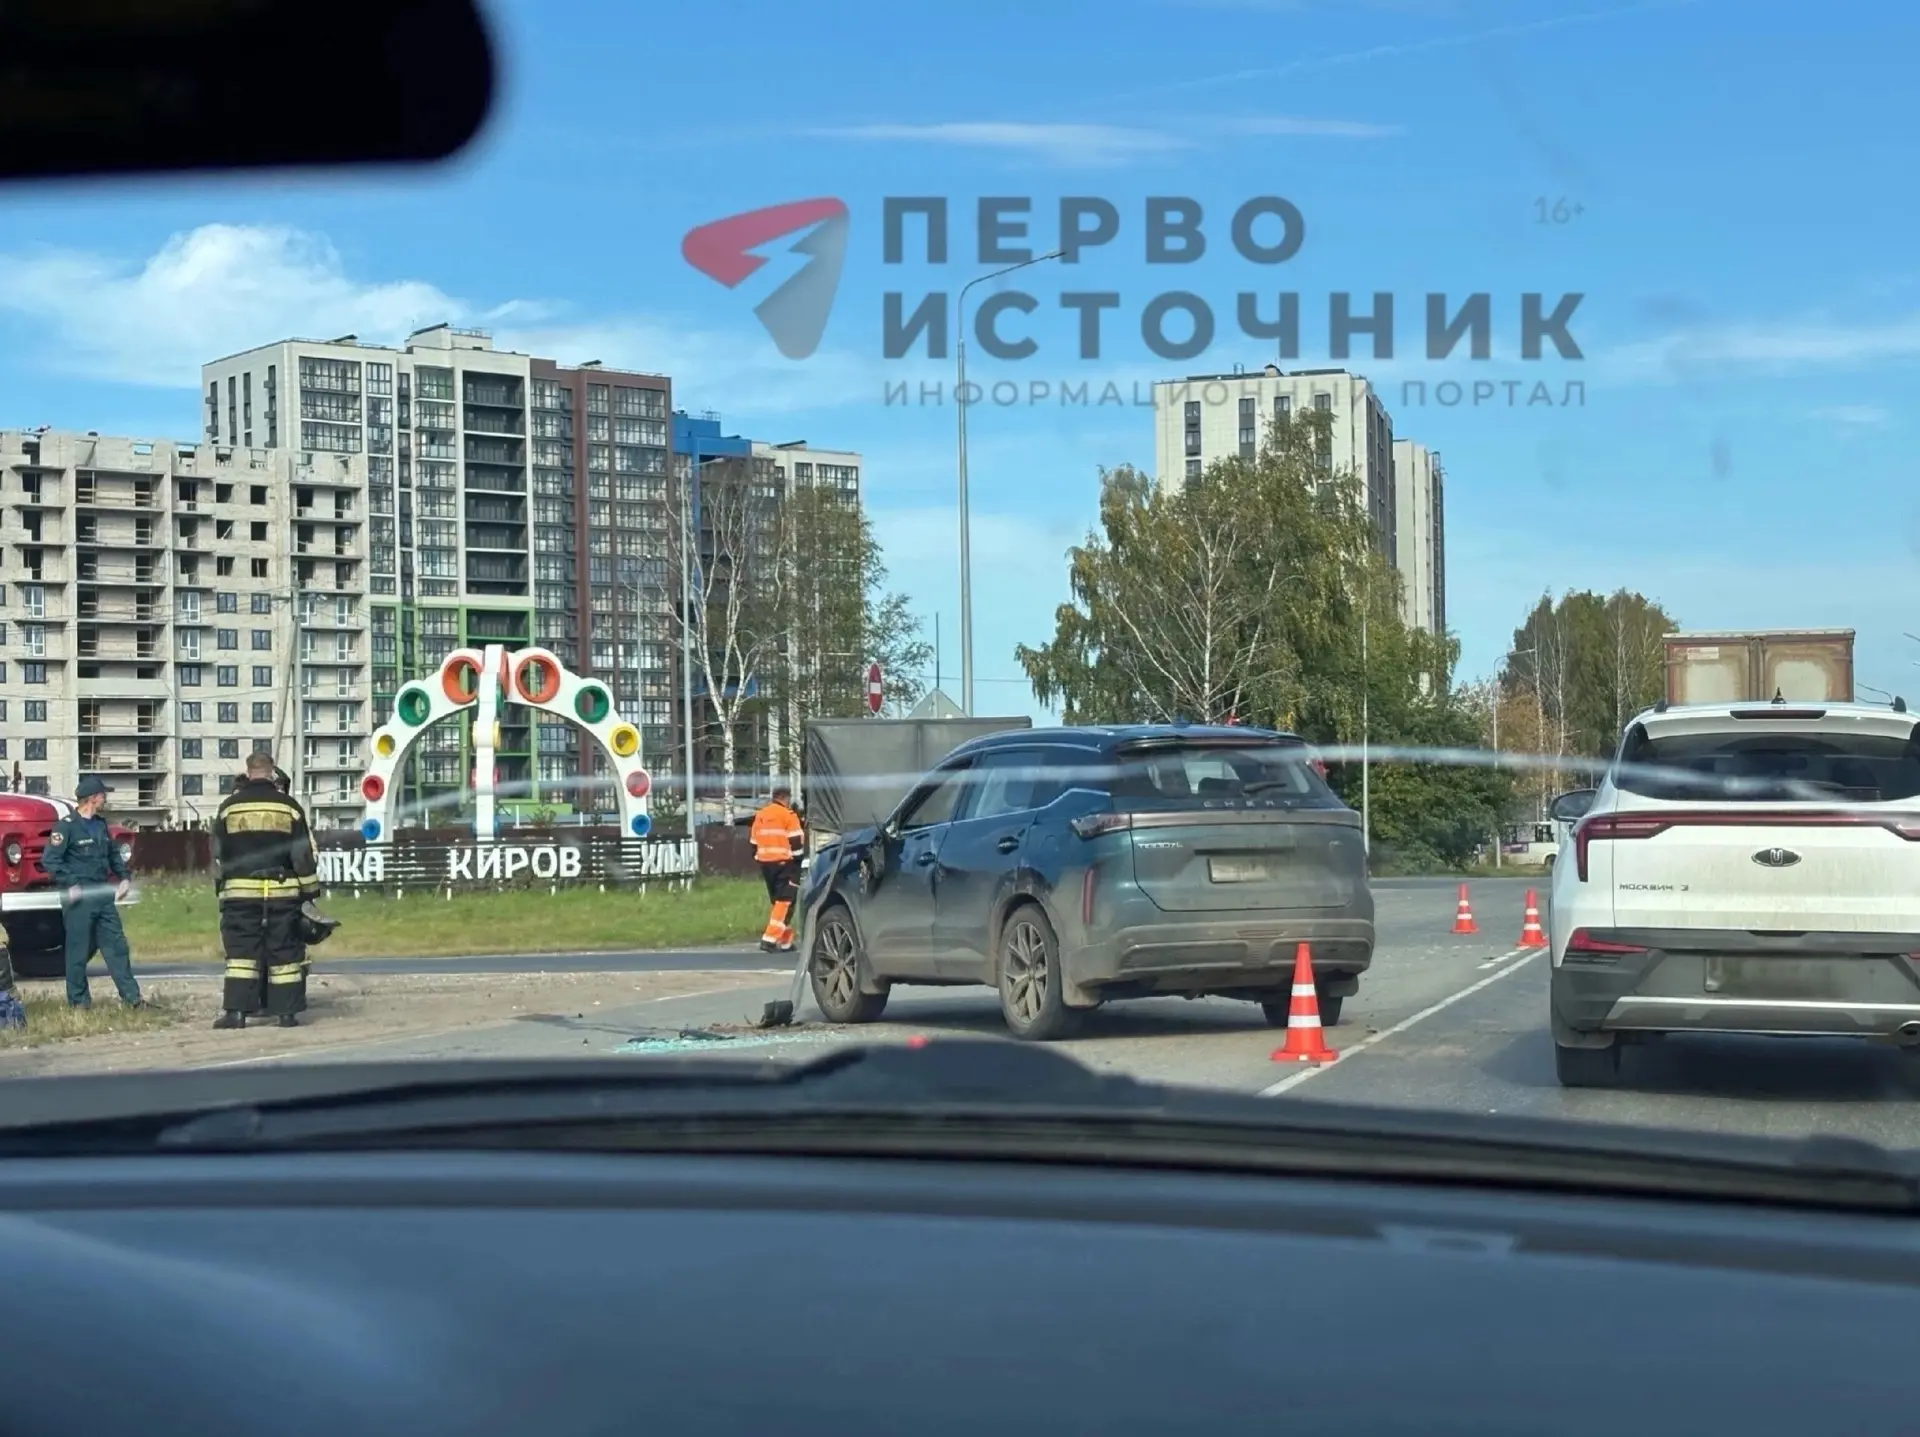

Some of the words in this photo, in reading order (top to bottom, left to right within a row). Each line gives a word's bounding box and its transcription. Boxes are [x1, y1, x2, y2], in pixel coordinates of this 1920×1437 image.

[1203, 800, 1294, 808] CHERY
[317, 850, 385, 882] ЯТКА
[450, 847, 582, 879] КИРОВ
